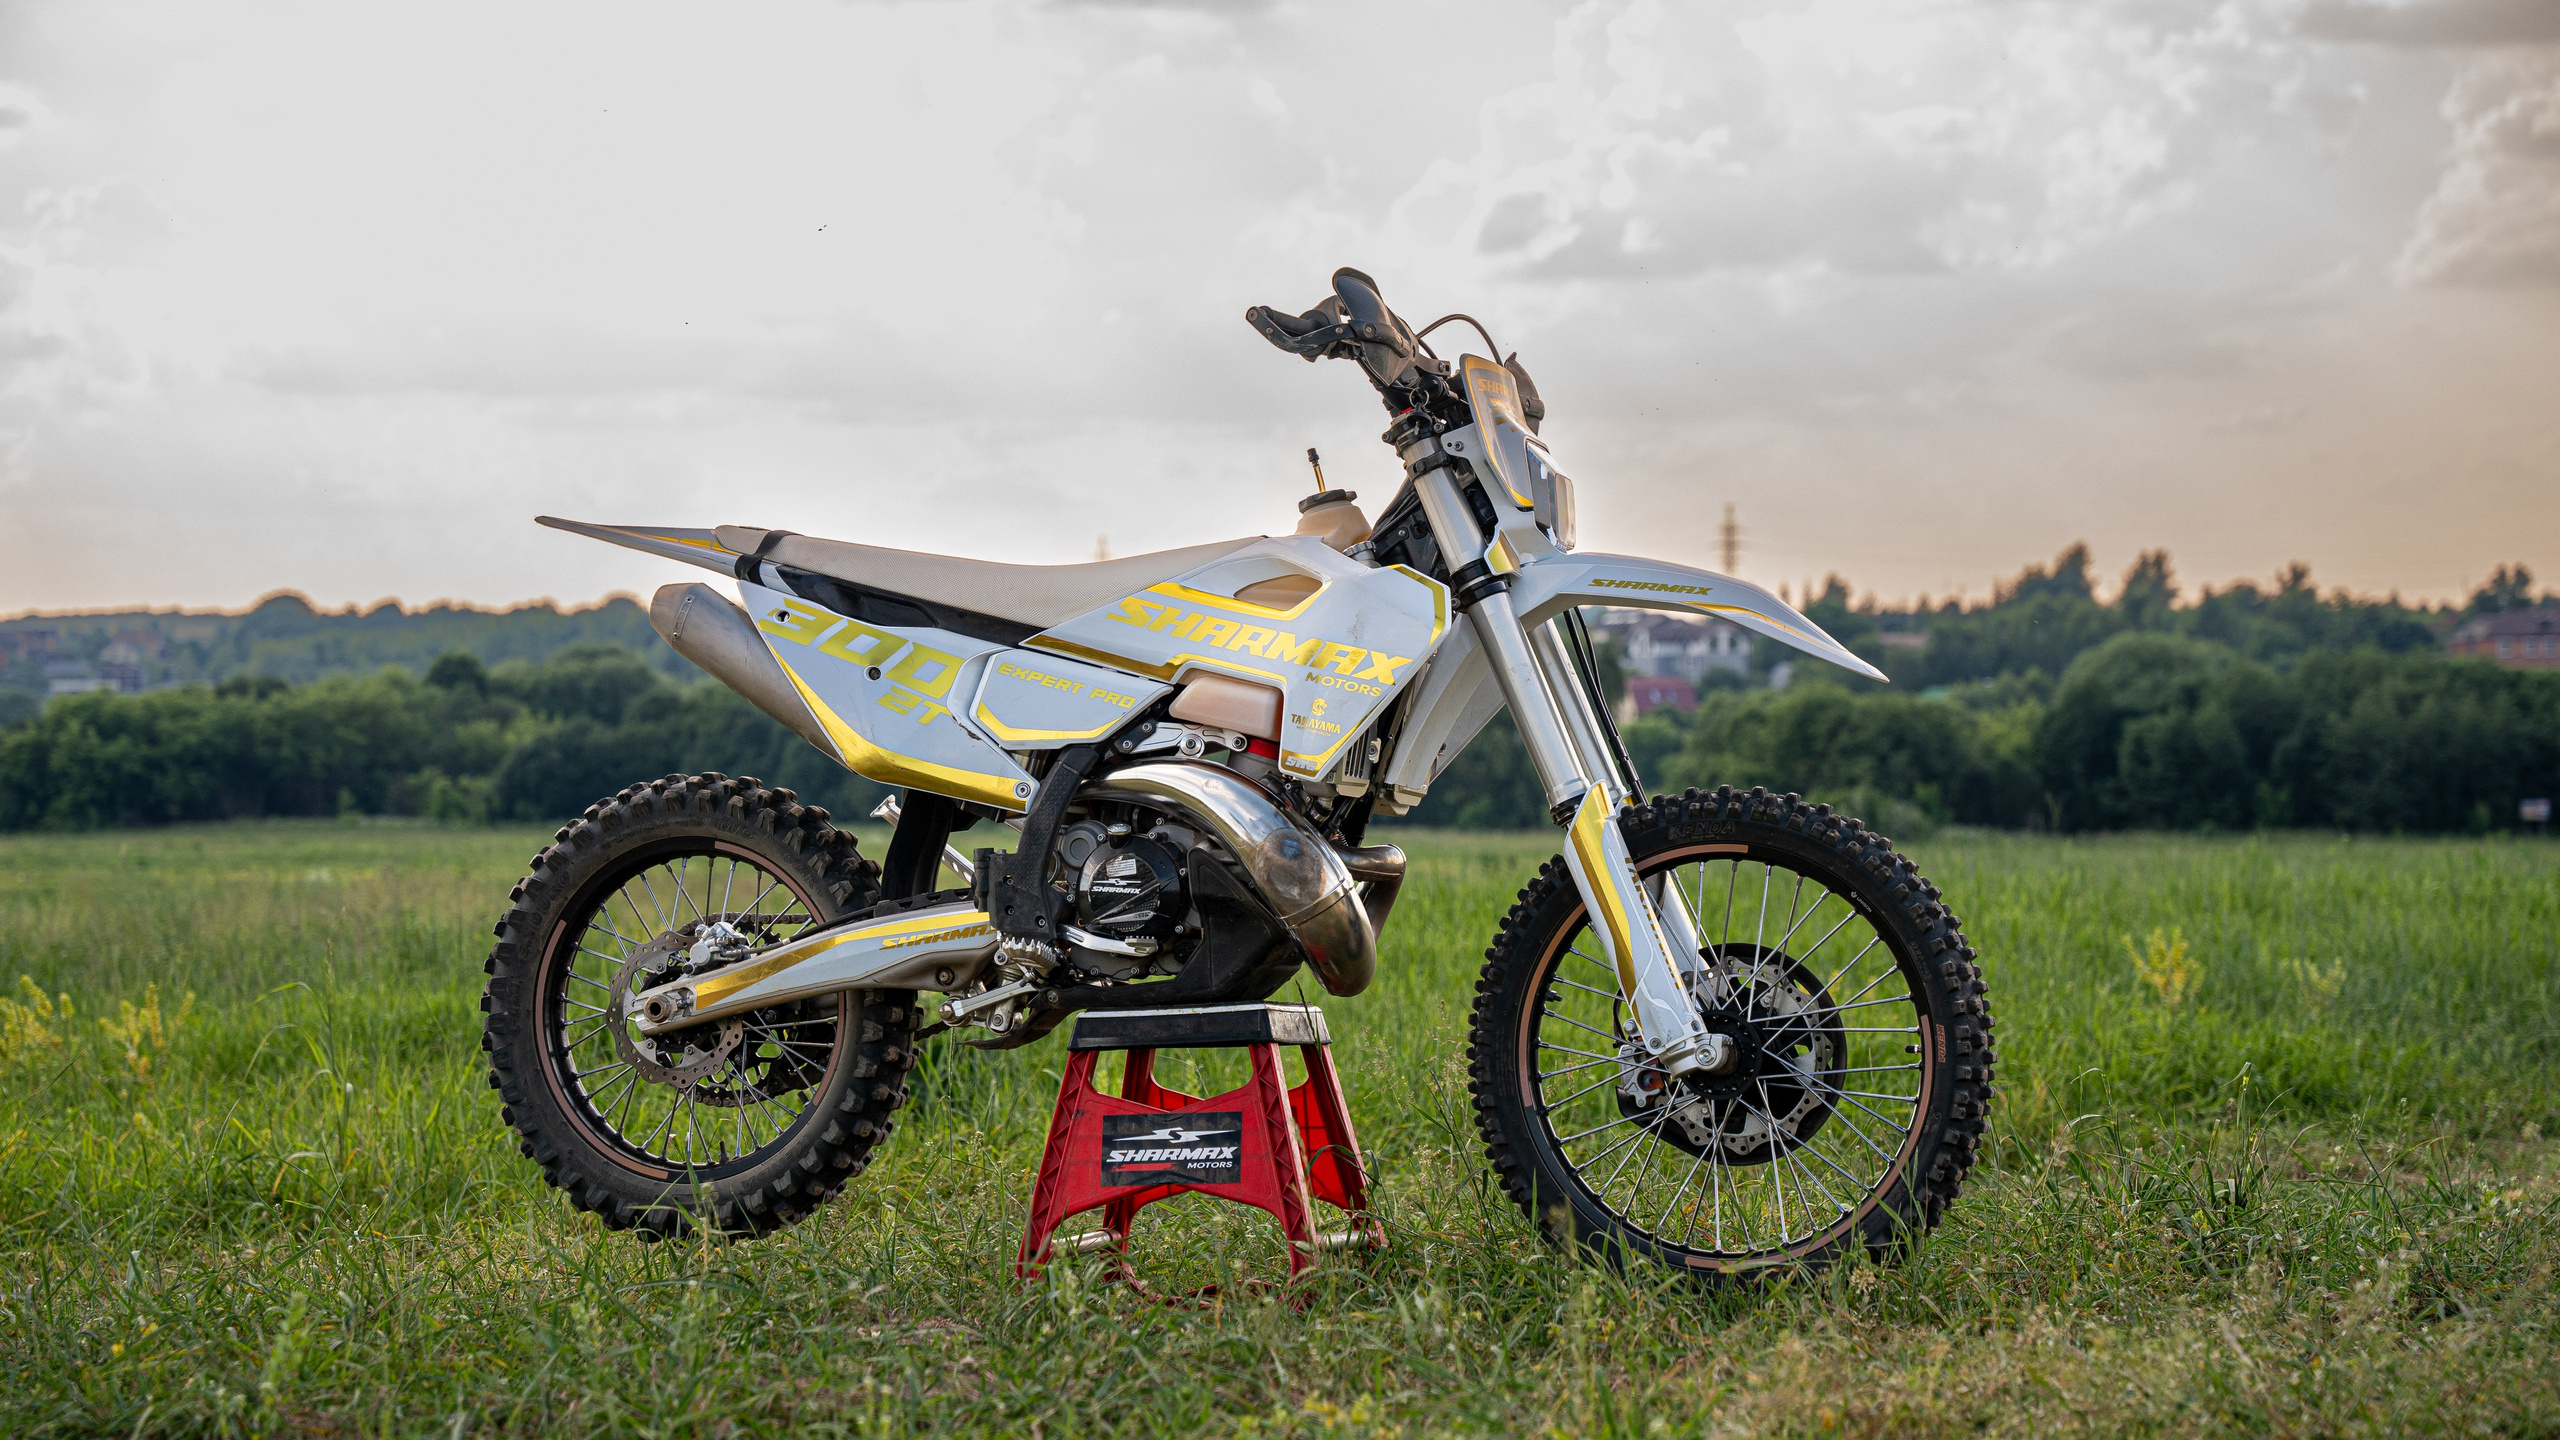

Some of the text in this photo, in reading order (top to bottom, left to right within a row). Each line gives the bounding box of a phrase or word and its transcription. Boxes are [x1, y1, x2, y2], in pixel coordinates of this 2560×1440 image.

[1588, 579, 1714, 595] SHARMAX
[758, 598, 966, 699] 300
[1105, 596, 1414, 686] SHARMAX
[997, 663, 1137, 709] EXPERT PRO
[1305, 672, 1382, 697] MOTORS
[877, 685, 952, 725] 2T
[1291, 713, 1341, 734] TAKAYAMA
[1668, 821, 1736, 840] KENDA
[1091, 886, 1141, 894] SHARMAX
[1936, 1024, 1946, 1062] KENDA
[1106, 1146, 1238, 1163] SHARMAX
[1187, 1161, 1233, 1169] MOTORS
